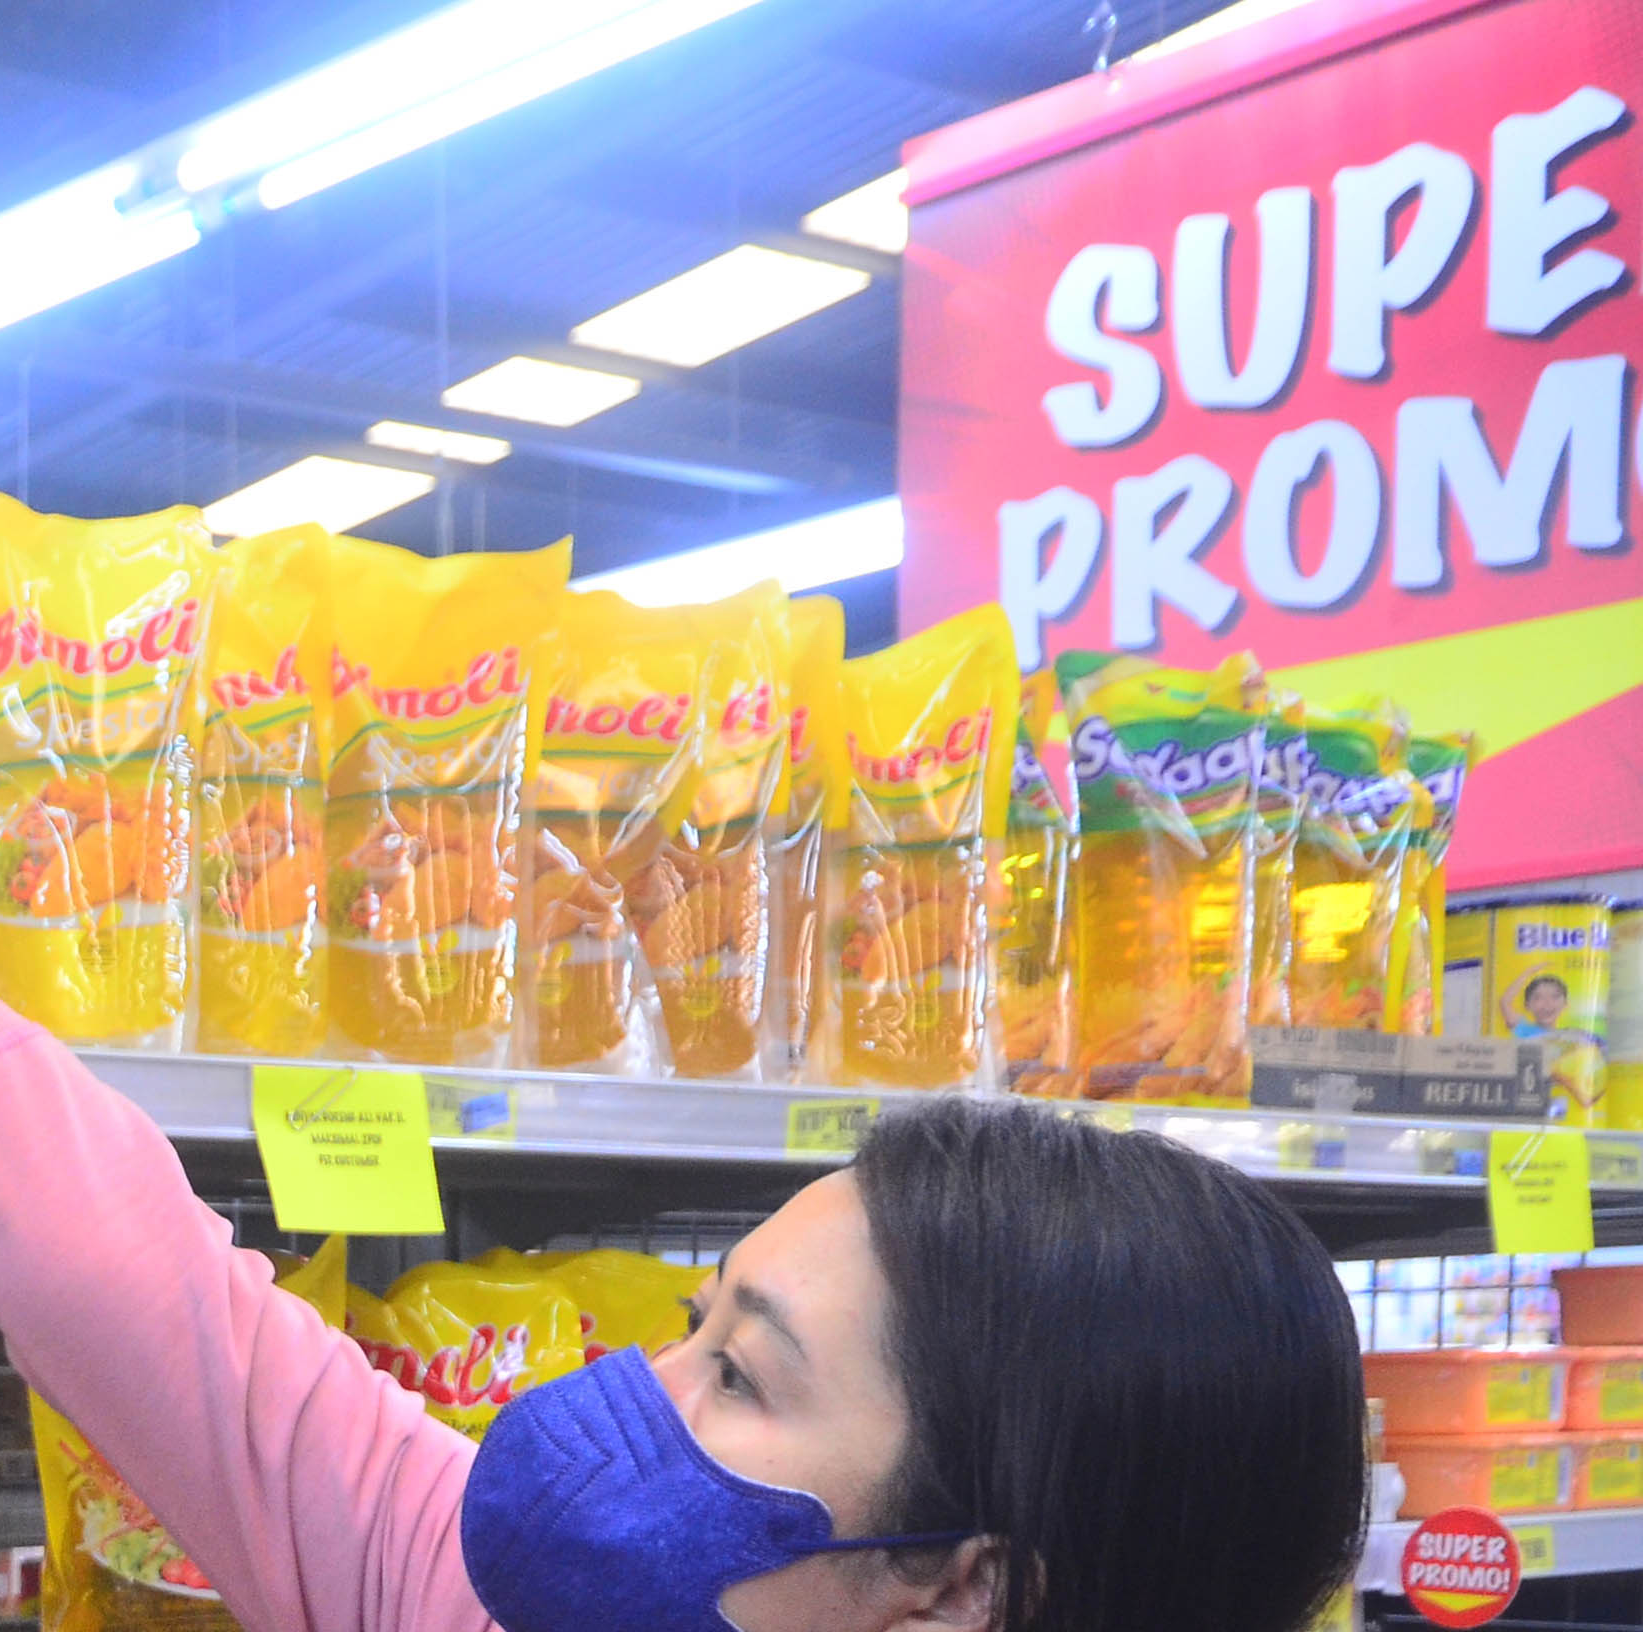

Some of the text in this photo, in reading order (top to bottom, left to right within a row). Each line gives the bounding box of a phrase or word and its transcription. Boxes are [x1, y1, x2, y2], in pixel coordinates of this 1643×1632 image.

[1042, 86, 1628, 450] SUPE
[998, 354, 1643, 674] PROM
[1409, 1559, 1511, 1593] PROMO!
[1415, 1531, 1509, 1565] SUPER
